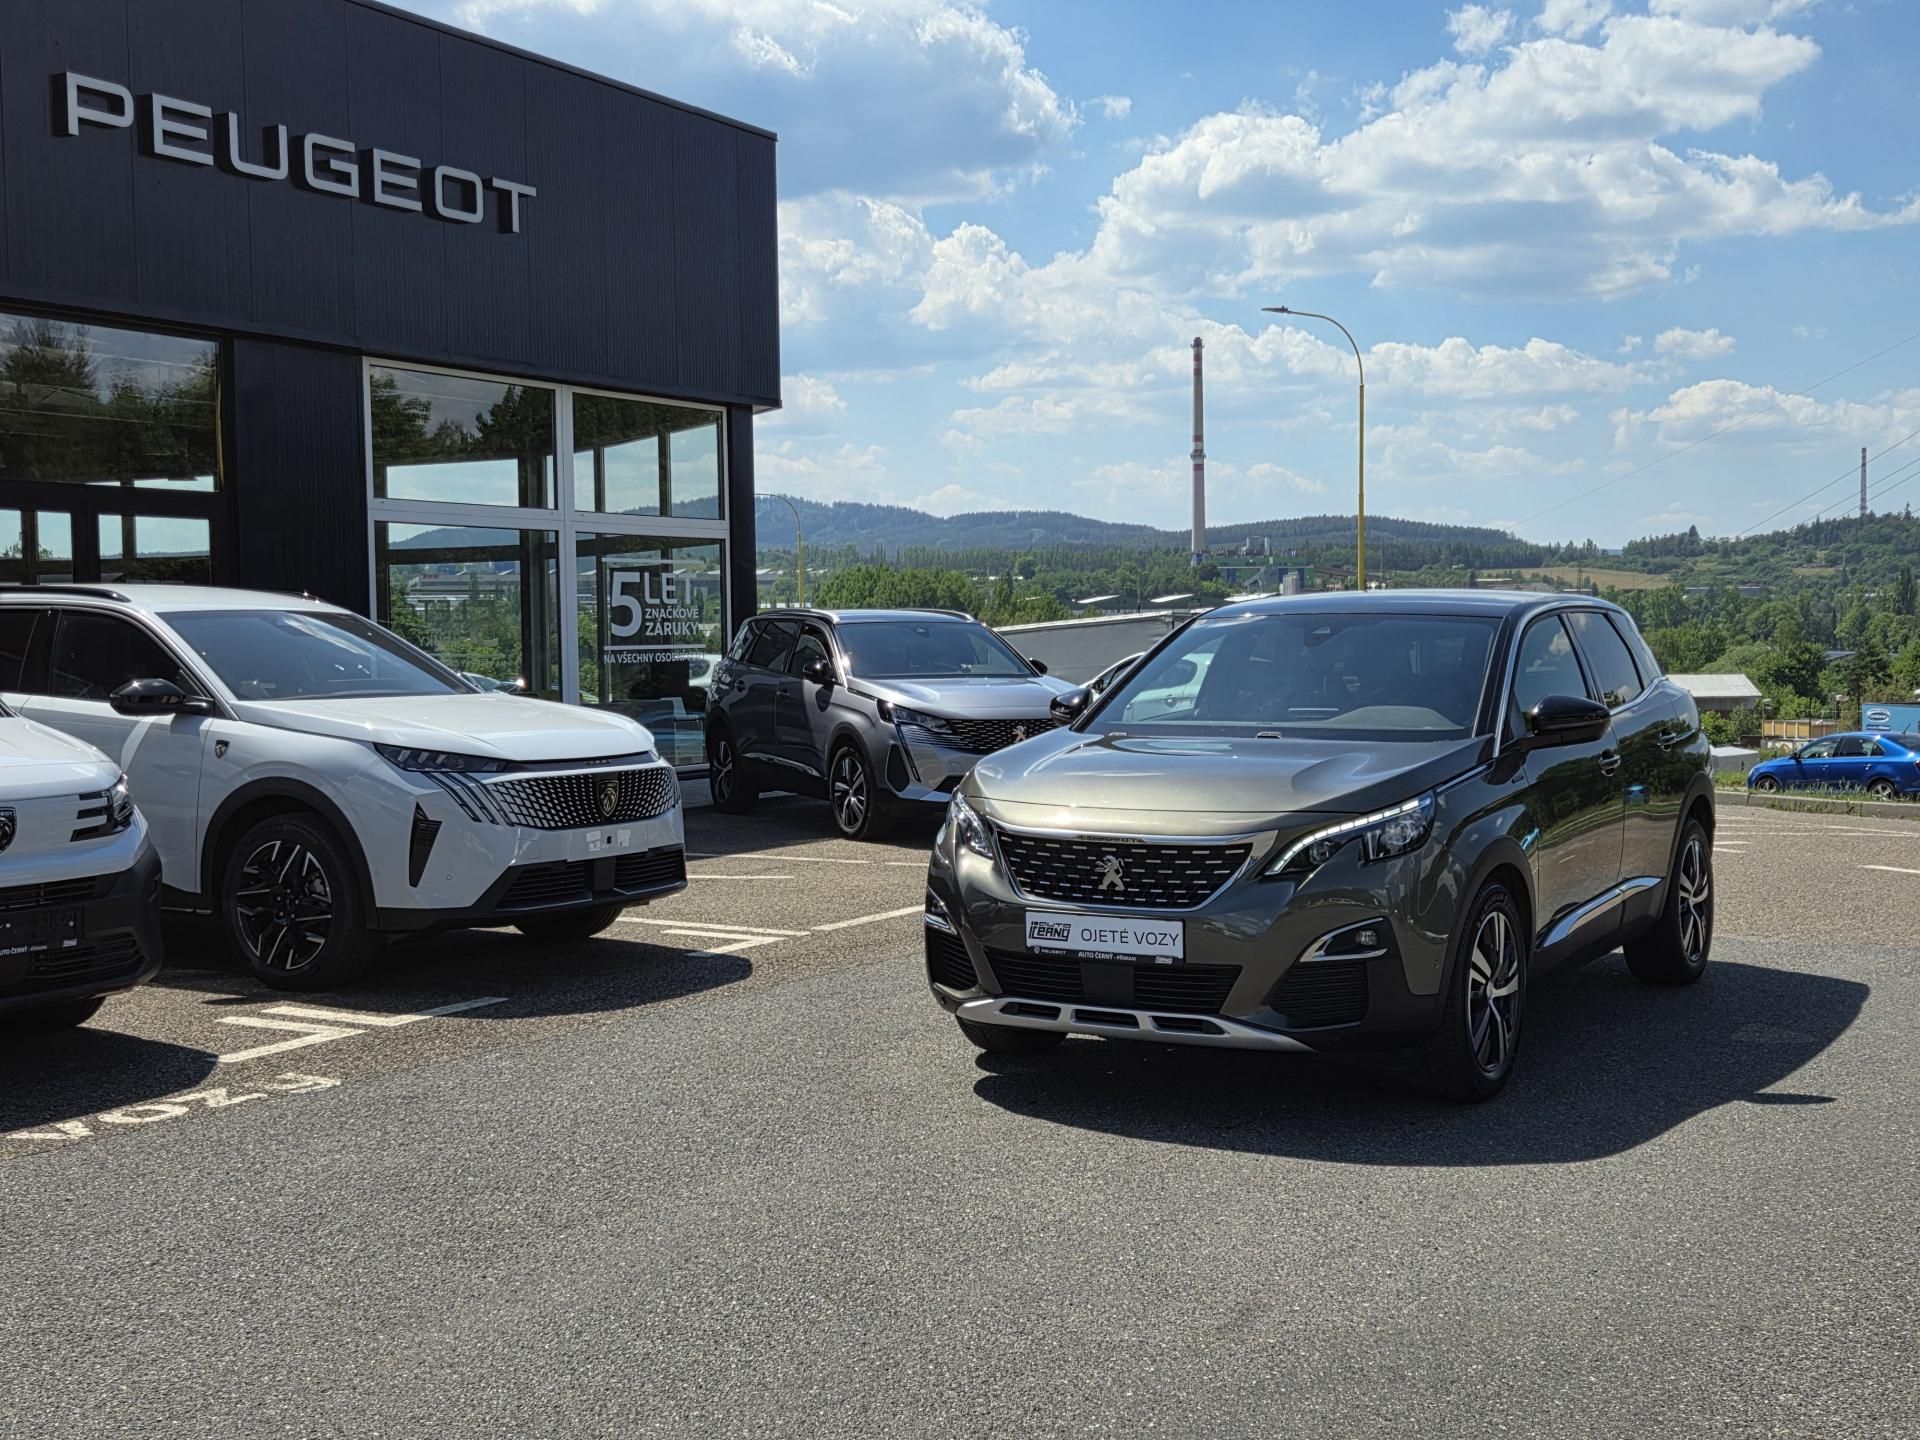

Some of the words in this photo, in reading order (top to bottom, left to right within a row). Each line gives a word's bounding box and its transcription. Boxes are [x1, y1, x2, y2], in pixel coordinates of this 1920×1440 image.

[64, 71, 538, 234] PEUGEOT
[611, 571, 643, 637] 5
[644, 571, 698, 605] LET
[645, 606, 699, 619] ZNAČKOVÉ
[645, 618, 699, 636] ZÁRUKY
[604, 654, 616, 664] NA
[617, 651, 654, 664] VŠECHNY
[1081, 928, 1129, 944] OJETÉ
[1133, 932, 1180, 947] VOZY
